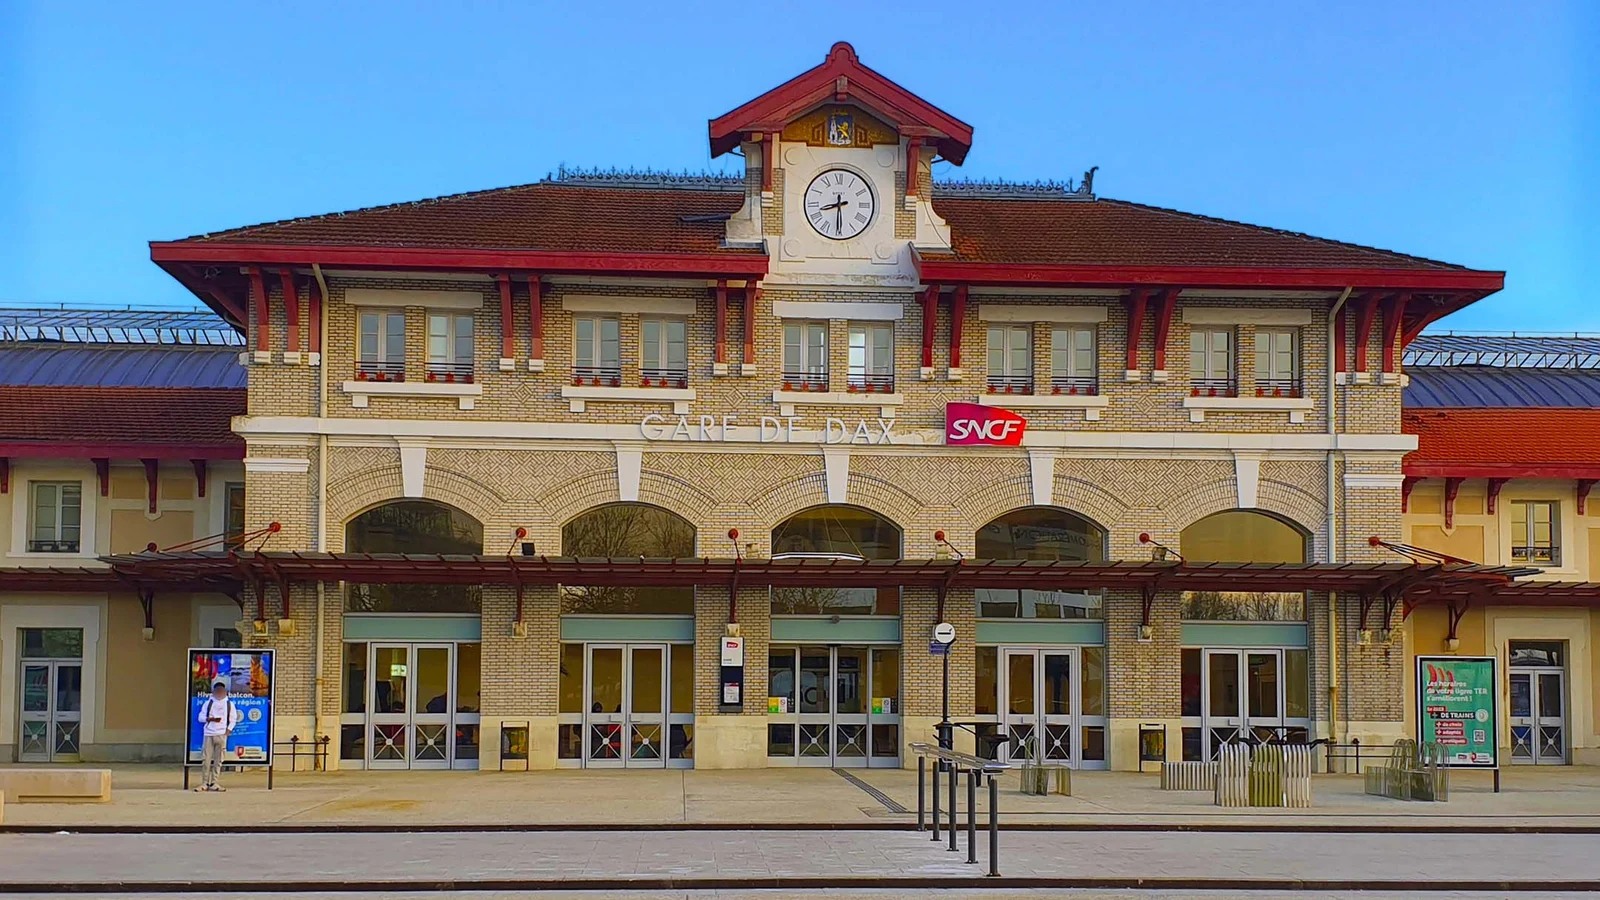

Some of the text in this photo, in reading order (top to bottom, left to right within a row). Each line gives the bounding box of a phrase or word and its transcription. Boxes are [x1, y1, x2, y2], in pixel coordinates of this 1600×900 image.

[640, 414, 896, 445] GARE DE DAX
[949, 419, 1022, 440] SNCF
